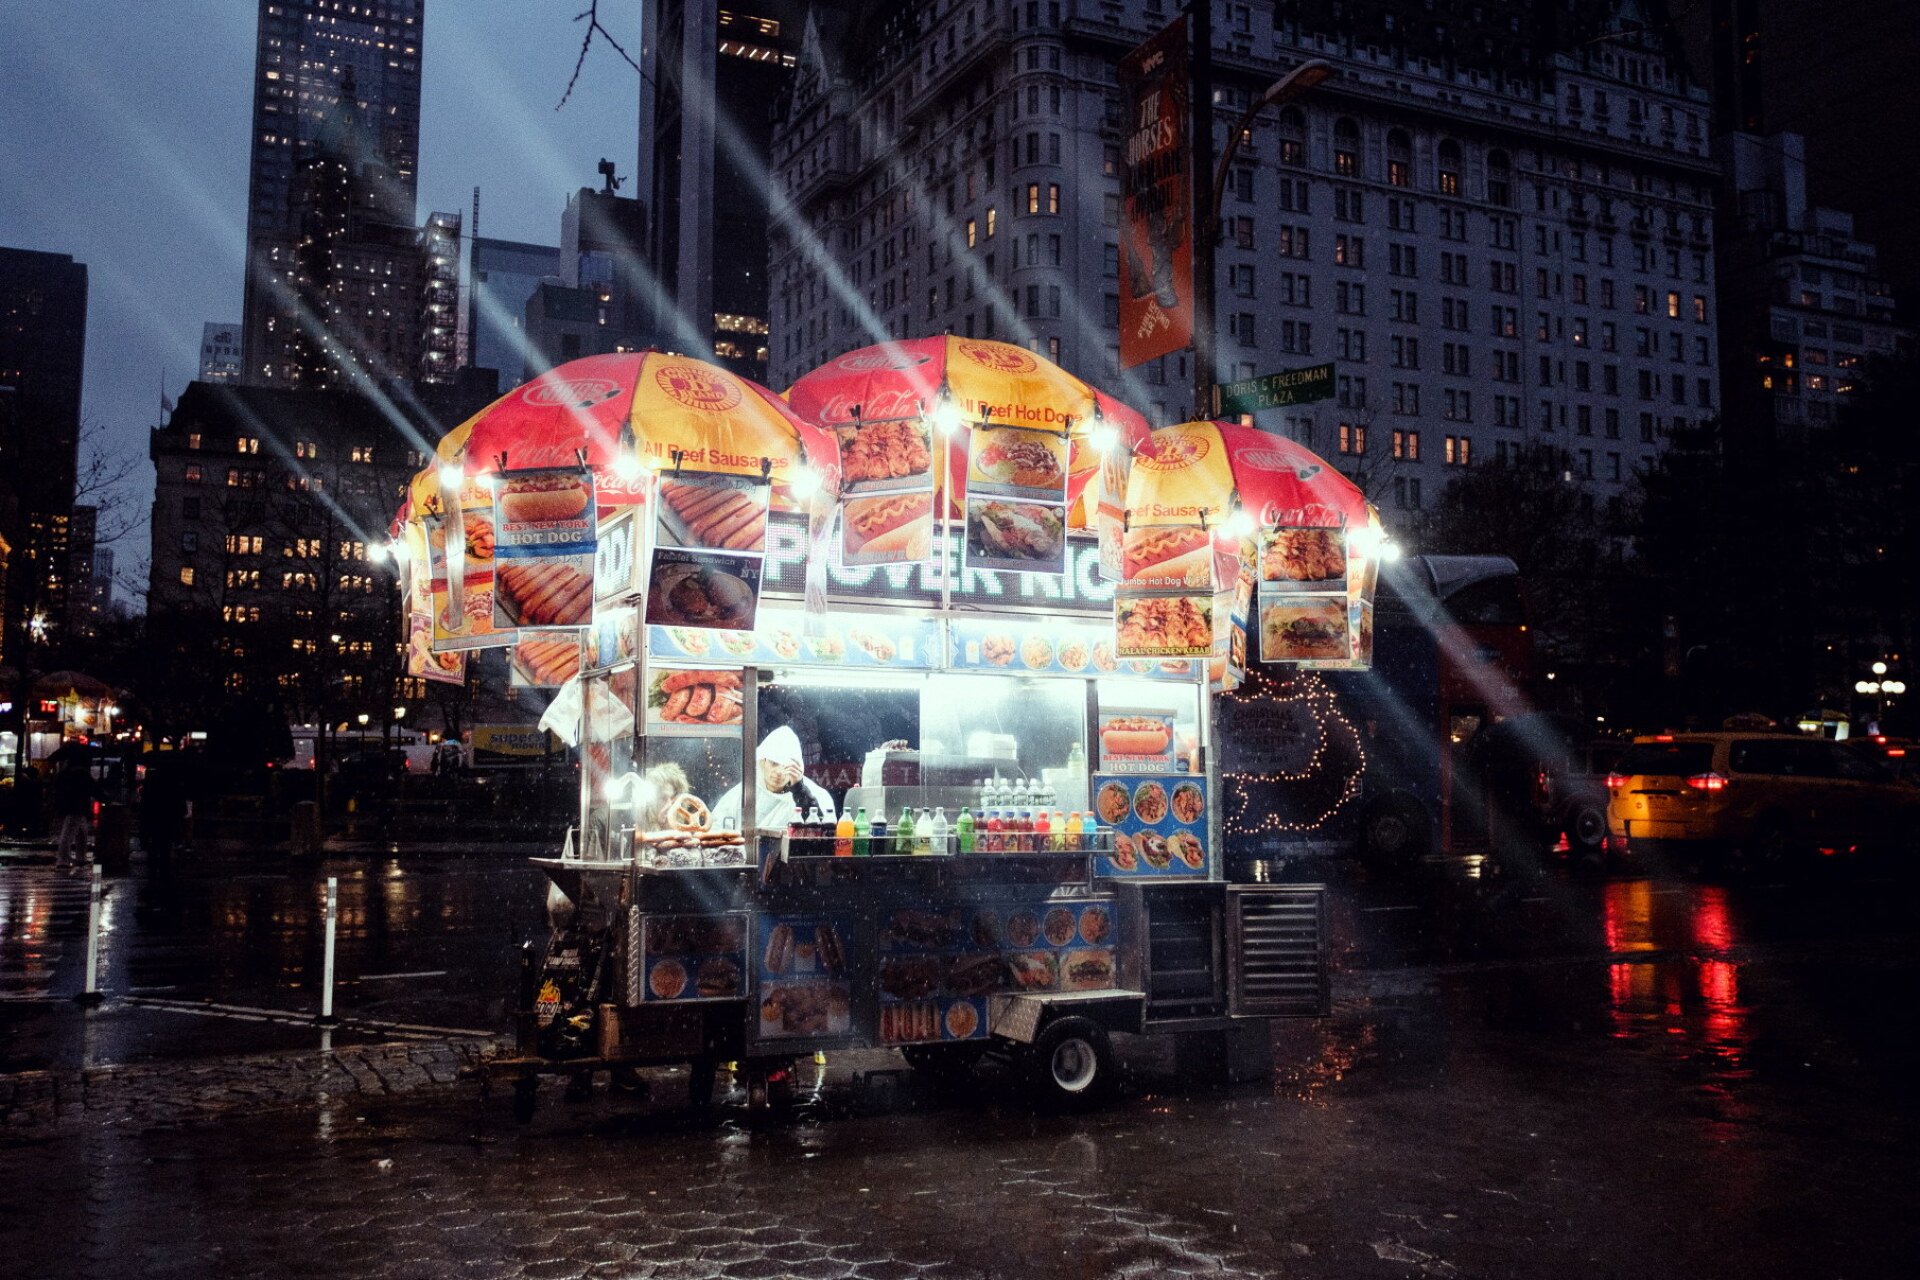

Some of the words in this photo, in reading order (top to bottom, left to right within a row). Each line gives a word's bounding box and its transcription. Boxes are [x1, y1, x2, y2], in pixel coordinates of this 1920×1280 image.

[1140, 90, 1160, 128] THE
[1127, 116, 1172, 167] HORSES
[1226, 381, 1257, 397] DORIS
[1262, 379, 1268, 391] C
[1272, 367, 1328, 388] FREEDMAN
[1258, 390, 1296, 406] PLAZA
[1016, 405, 1042, 421] Hot
[645, 441, 662, 458] All
[503, 523, 527, 532] BEST
[531, 521, 557, 531] NEW
[559, 519, 590, 529] YORK
[510, 533, 543, 545] HOT
[548, 531, 582, 543] DOG
[740, 568, 760, 578] NY
[1121, 577, 1147, 586] Jumbo
[1149, 577, 1163, 586] Hot
[1165, 576, 1182, 587] Dog
[1119, 647, 1145, 655] HALAL
[1147, 647, 1183, 655] CHICKEN
[1103, 754, 1123, 762] BEST
[1124, 754, 1144, 762] NEW
[1109, 763, 1136, 772] HOT
[1138, 763, 1165, 772] DOG
[1070, 835, 1078, 845] G
